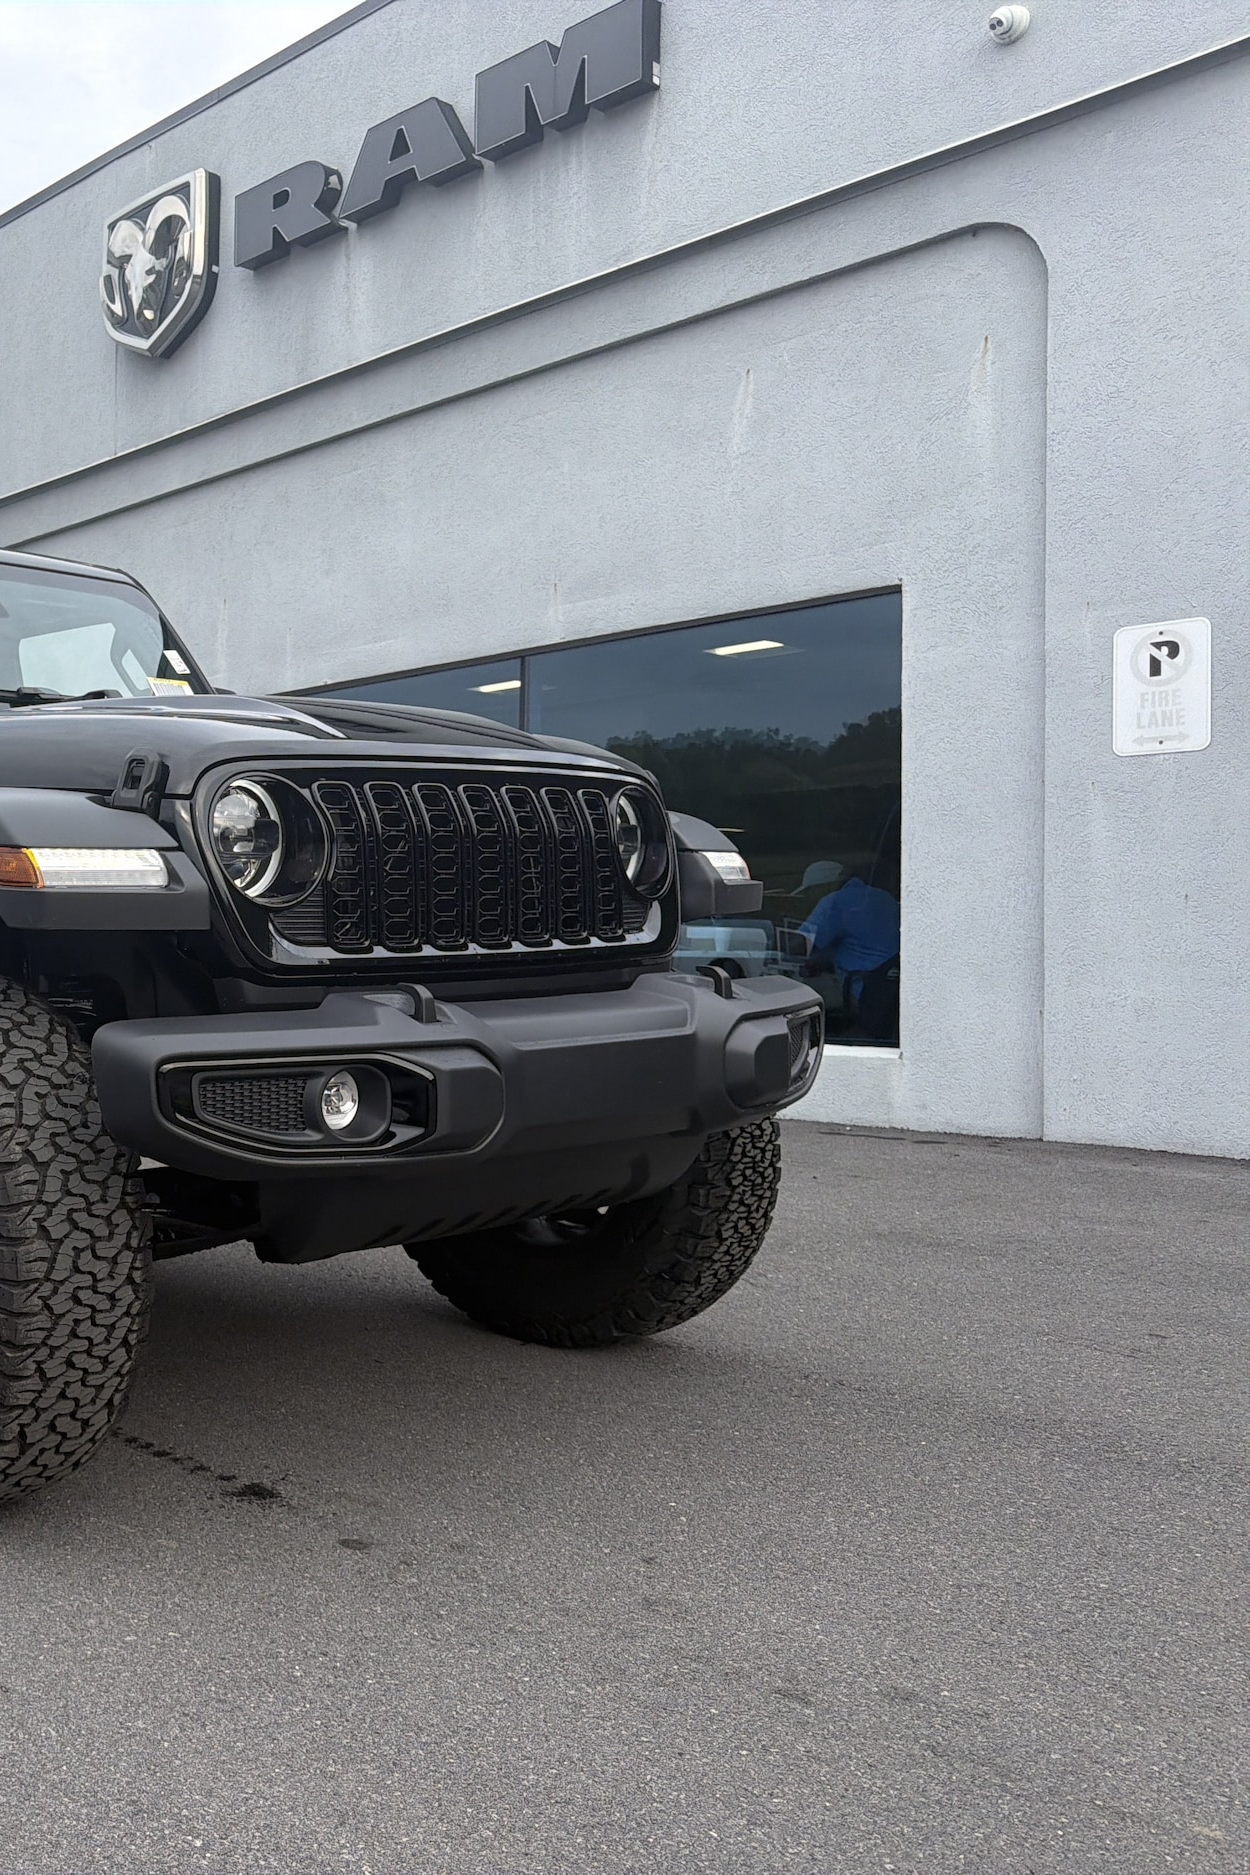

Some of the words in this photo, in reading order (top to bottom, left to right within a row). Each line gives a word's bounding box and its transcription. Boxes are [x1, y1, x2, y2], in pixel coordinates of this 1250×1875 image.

[235, 0, 659, 270] RAM
[1139, 688, 1183, 710] FIRE
[1135, 708, 1186, 729] LANE
